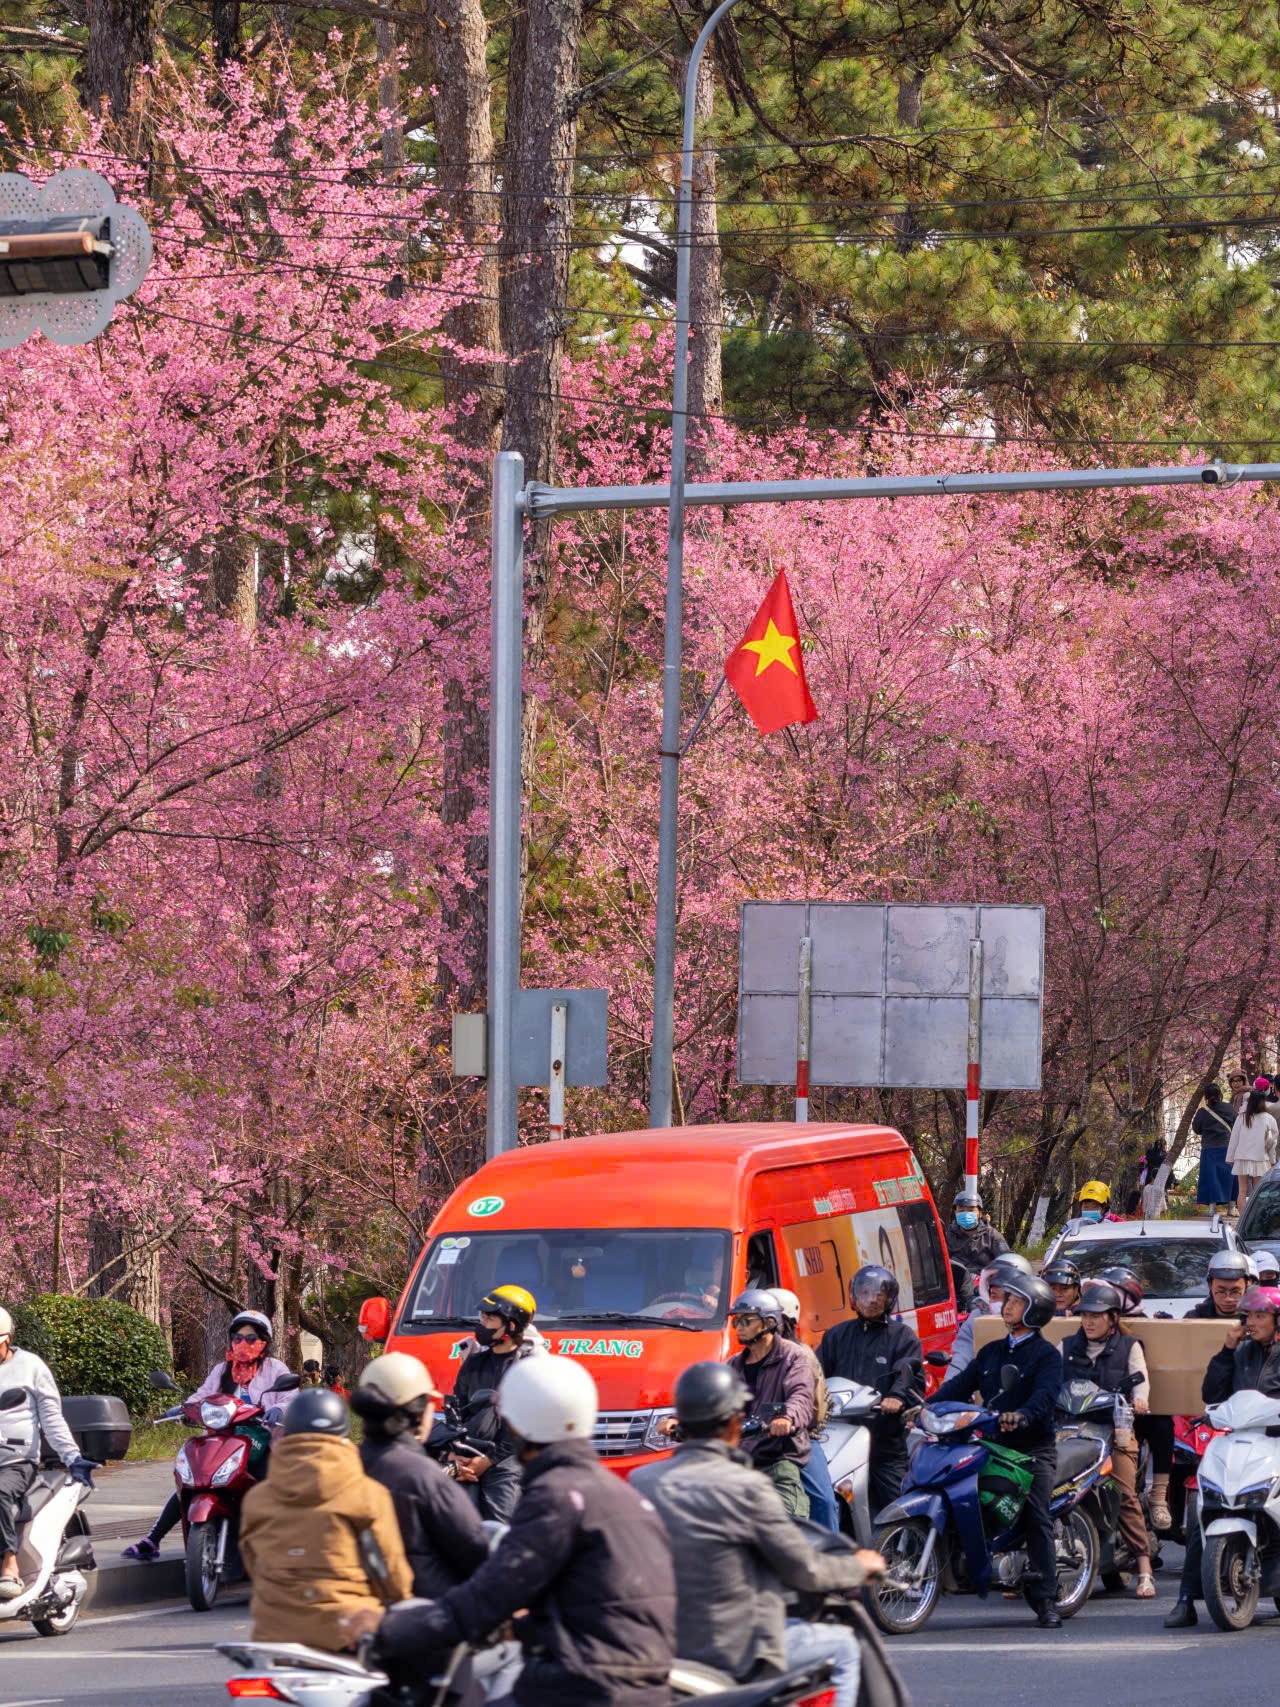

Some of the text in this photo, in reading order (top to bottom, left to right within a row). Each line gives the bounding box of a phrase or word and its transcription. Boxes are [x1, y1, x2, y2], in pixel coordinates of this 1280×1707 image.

[472, 1200, 498, 1213] 07
[804, 1246, 823, 1275] SHB
[558, 1339, 643, 1358] TRANG
